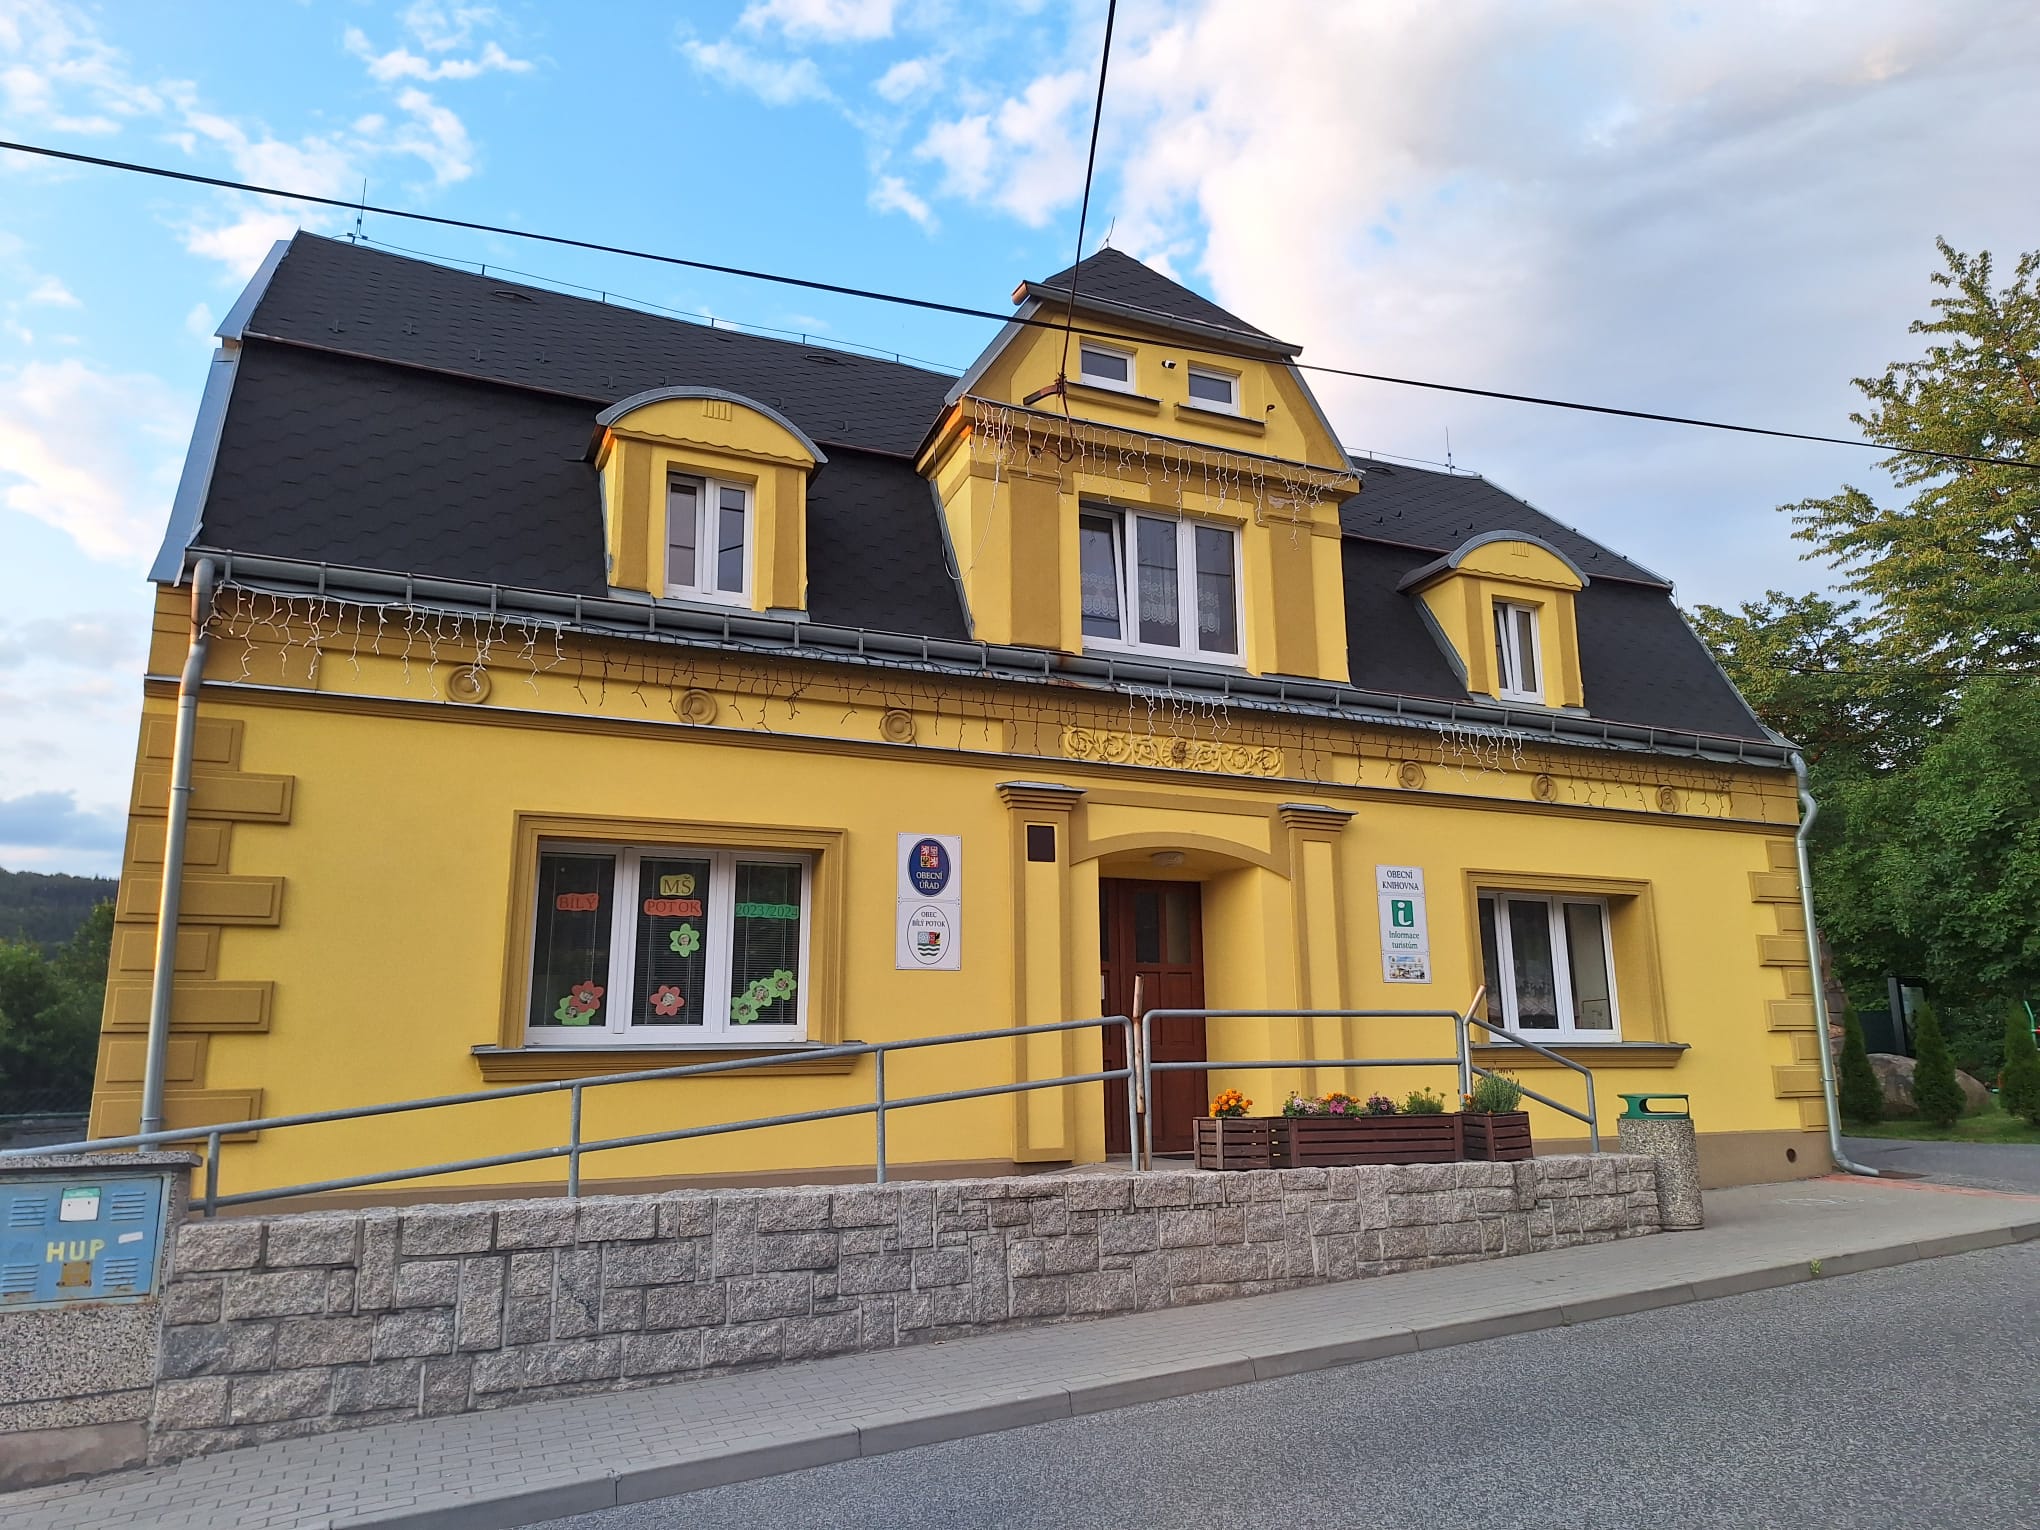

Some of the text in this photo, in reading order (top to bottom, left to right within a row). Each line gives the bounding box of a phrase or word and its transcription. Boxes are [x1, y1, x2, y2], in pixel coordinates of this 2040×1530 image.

[916, 871, 943, 879] OBECNÍ
[1386, 870, 1413, 879] OBECNÍ
[663, 875, 692, 893] MŠ
[919, 879, 940, 889] ÚŘAD
[1382, 881, 1419, 890] KNIHOVNA
[559, 894, 700, 912] BÍLÝ POTOK
[912, 919, 924, 927] BÍLÝ
[1388, 930, 1420, 939] Informace
[46, 1239, 105, 1263] HUP
